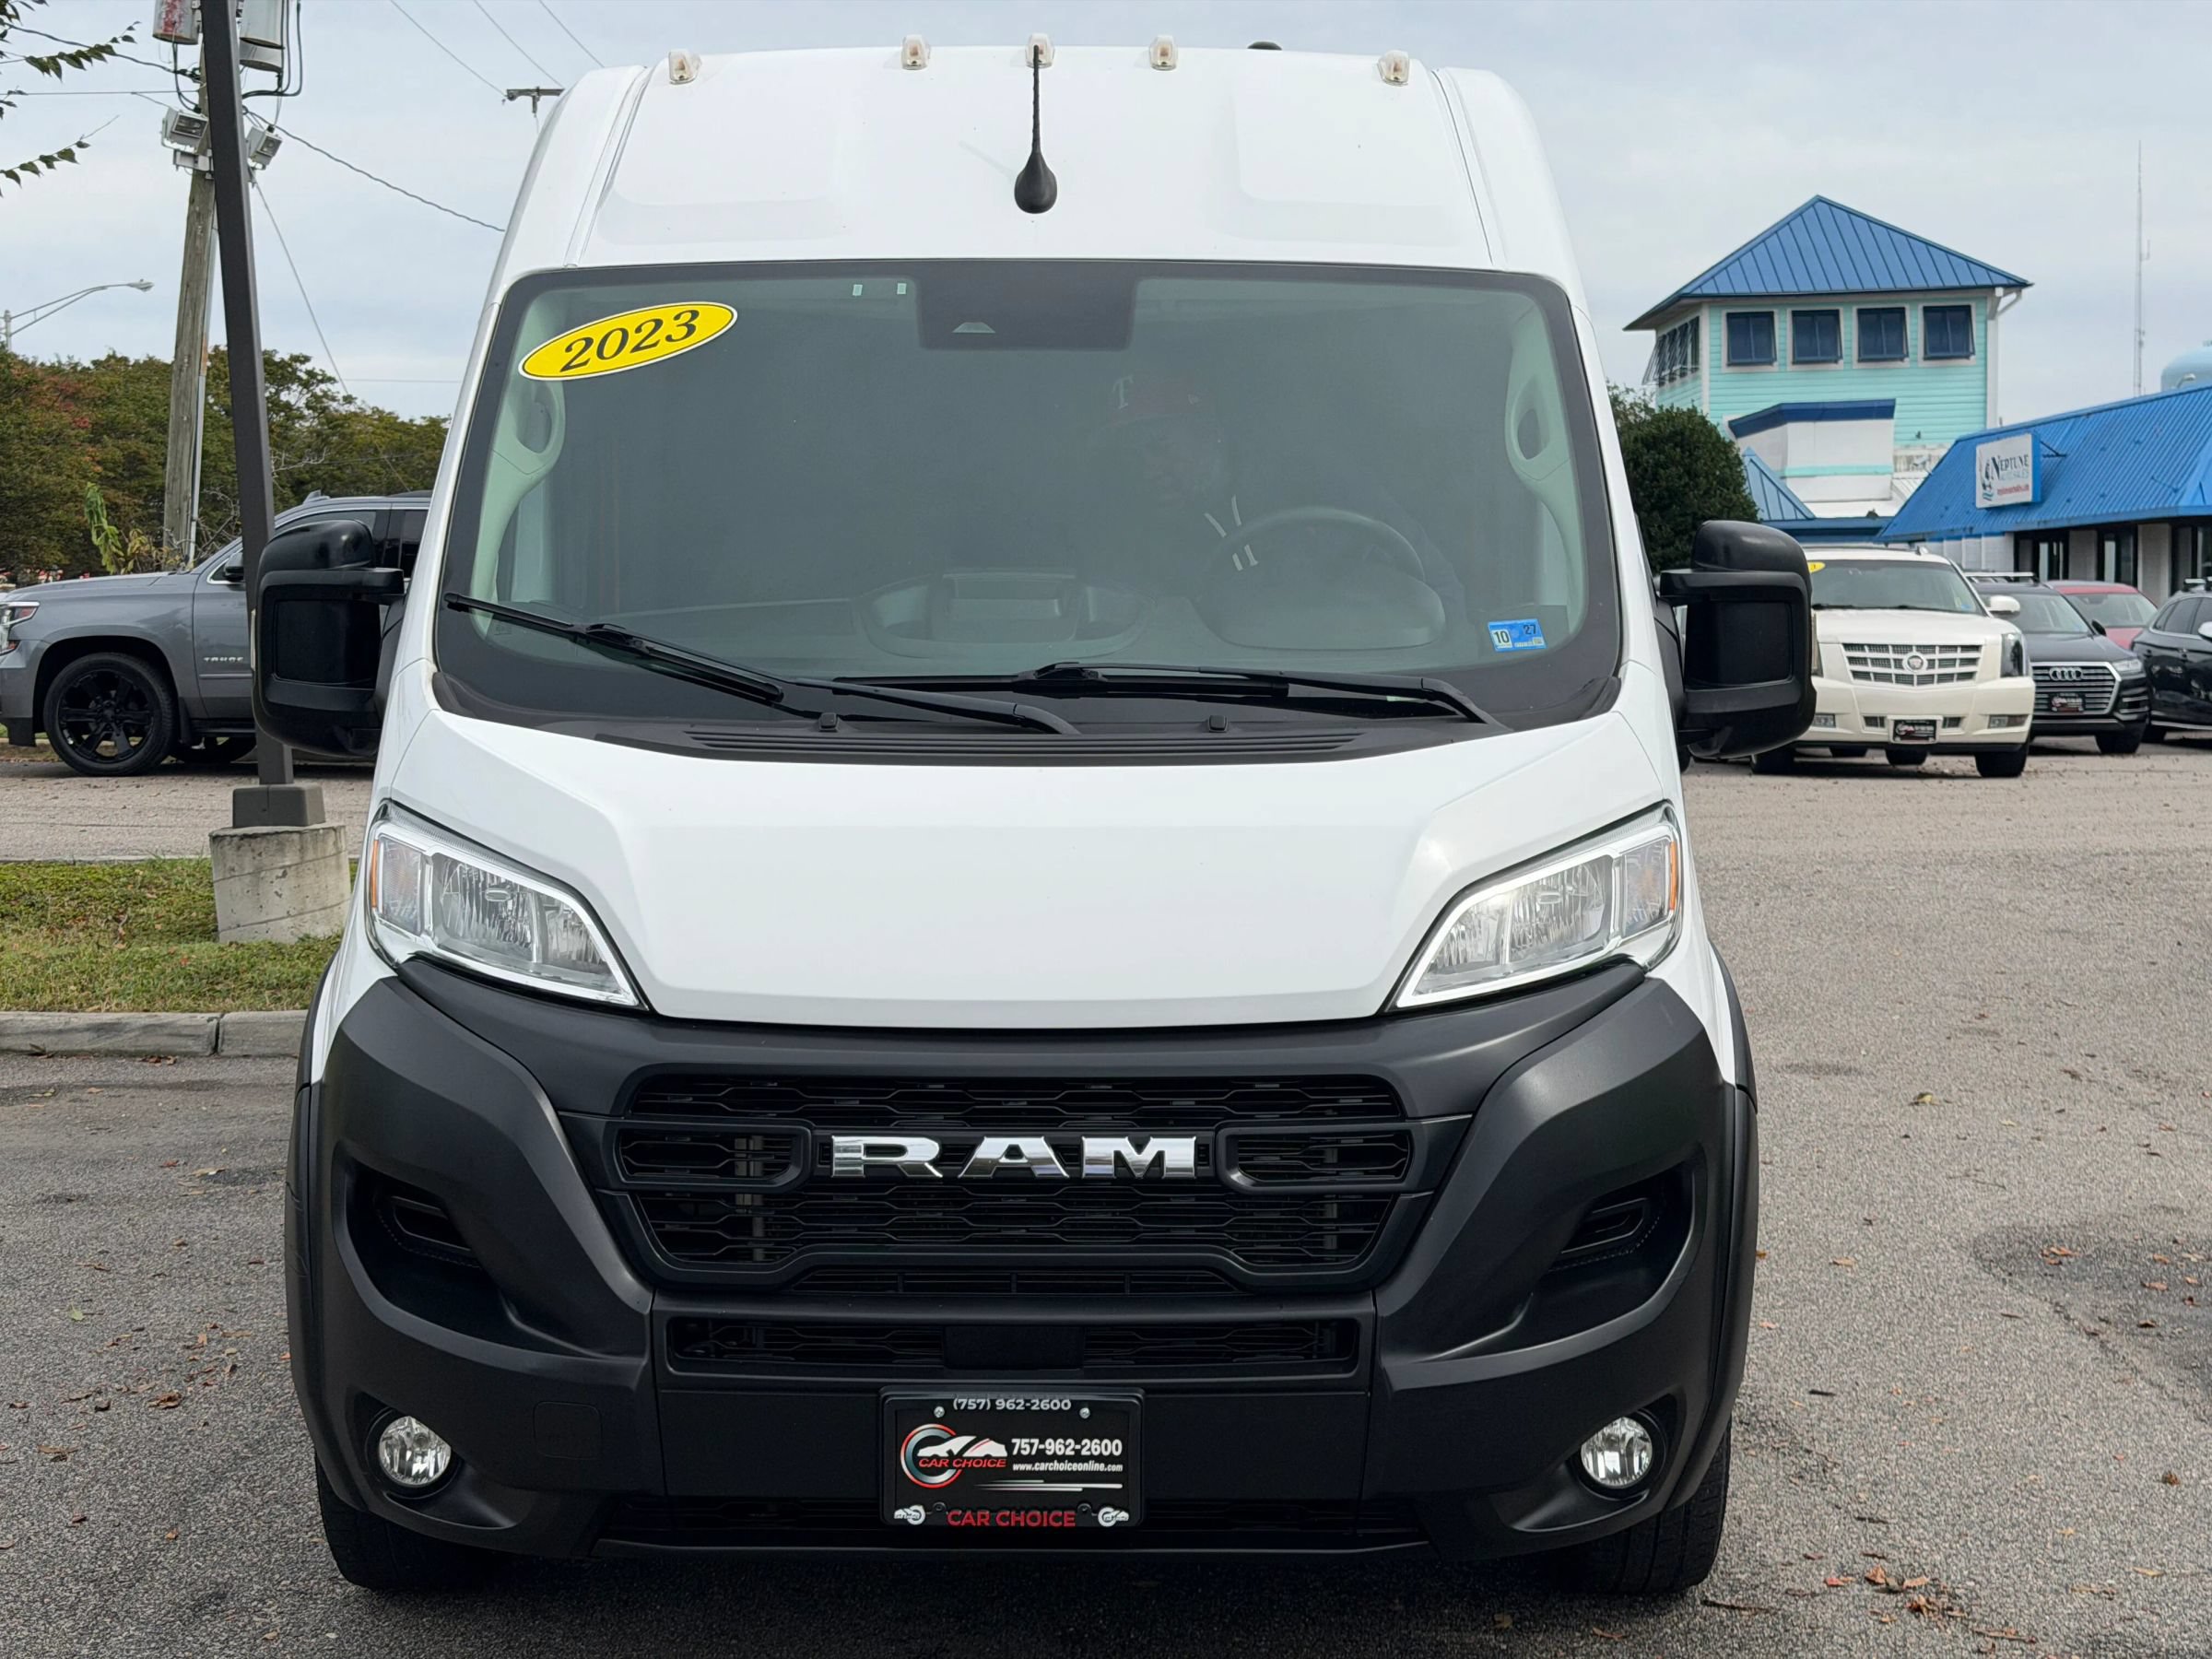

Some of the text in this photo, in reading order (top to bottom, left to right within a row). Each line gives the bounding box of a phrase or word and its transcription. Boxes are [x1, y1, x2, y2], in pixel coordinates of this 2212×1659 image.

[559, 309, 700, 373] 2023
[1990, 454, 2030, 480] NEPTUNE
[1493, 630, 1510, 643] 10
[1523, 624, 1536, 635] 27
[831, 1135, 1197, 1179] RAM
[953, 1398, 1072, 1411] (757) 962-2600
[1011, 1438, 1123, 1456] 757-962-2600
[918, 1458, 1007, 1468] CAR CHOICE
[1012, 1459, 1124, 1472] www.carchoiceonline.com
[947, 1509, 1077, 1527] CAR CHOICE
